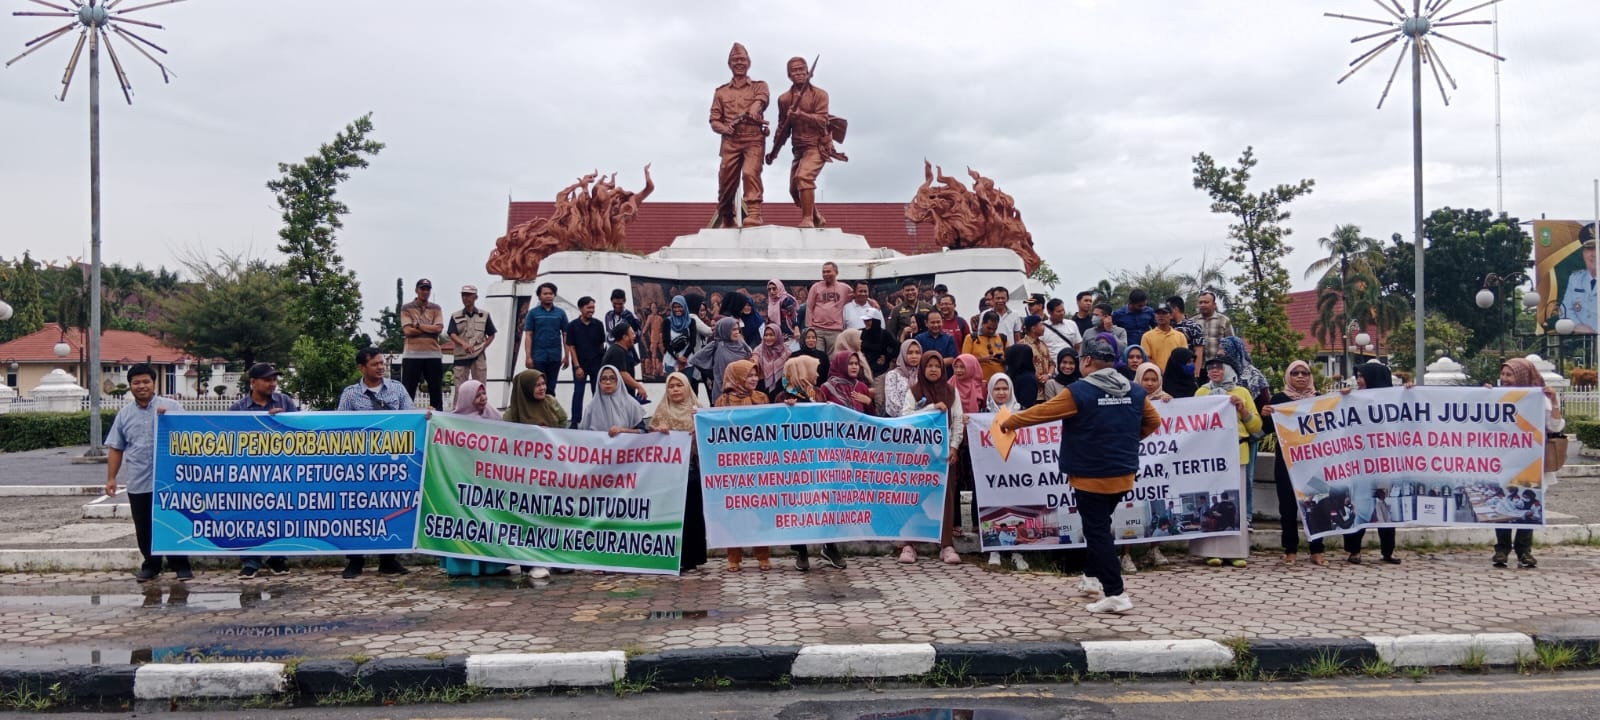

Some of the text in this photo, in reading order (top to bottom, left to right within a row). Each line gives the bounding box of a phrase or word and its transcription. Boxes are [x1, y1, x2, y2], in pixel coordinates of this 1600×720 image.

[1297, 402, 1518, 435] KERJA UDAH JUJUR
[169, 430, 415, 456] HARGAI PENGORBANAN KAMI
[707, 422, 943, 445] JANGAN TUDUH KAMI CURANG
[980, 428, 1032, 447] KMI
[433, 427, 682, 465] ANGGOTA KPPS SUDAH BEKERJA
[1138, 440, 1178, 456] 2024
[1290, 431, 1533, 463] MENGURAS TENAGA DAN PIKIRAN
[718, 449, 930, 467] BERKERJA SAAT MASYARAKAT TIDUR
[1431, 456, 1502, 473] CURANG
[175, 464, 408, 482] SUDAH BANYAK PETUGAS KPPS
[475, 461, 637, 489] PENUH PERJUANGAN
[705, 473, 754, 489] NYEYAK
[758, 470, 813, 486] MENJADI
[816, 469, 852, 483] IKHTIAR
[854, 470, 907, 485] PETUGAS
[986, 473, 1033, 488] YANG
[1173, 458, 1227, 475] TERTIB
[159, 492, 203, 511] YANG
[205, 492, 294, 511] MENINGGAL
[298, 492, 335, 509] DEMI
[457, 484, 651, 521] TIDAK PANTAS DITUDUH
[725, 490, 919, 510] DENGAN TUJUAN TAHAPAN PEMILU
[193, 519, 387, 538] DEMOKRASI DI INDONESIA
[775, 510, 871, 528] BERJALAN LANCAR
[424, 513, 677, 557] SEBAGAI PELAKU KECURANGAN
